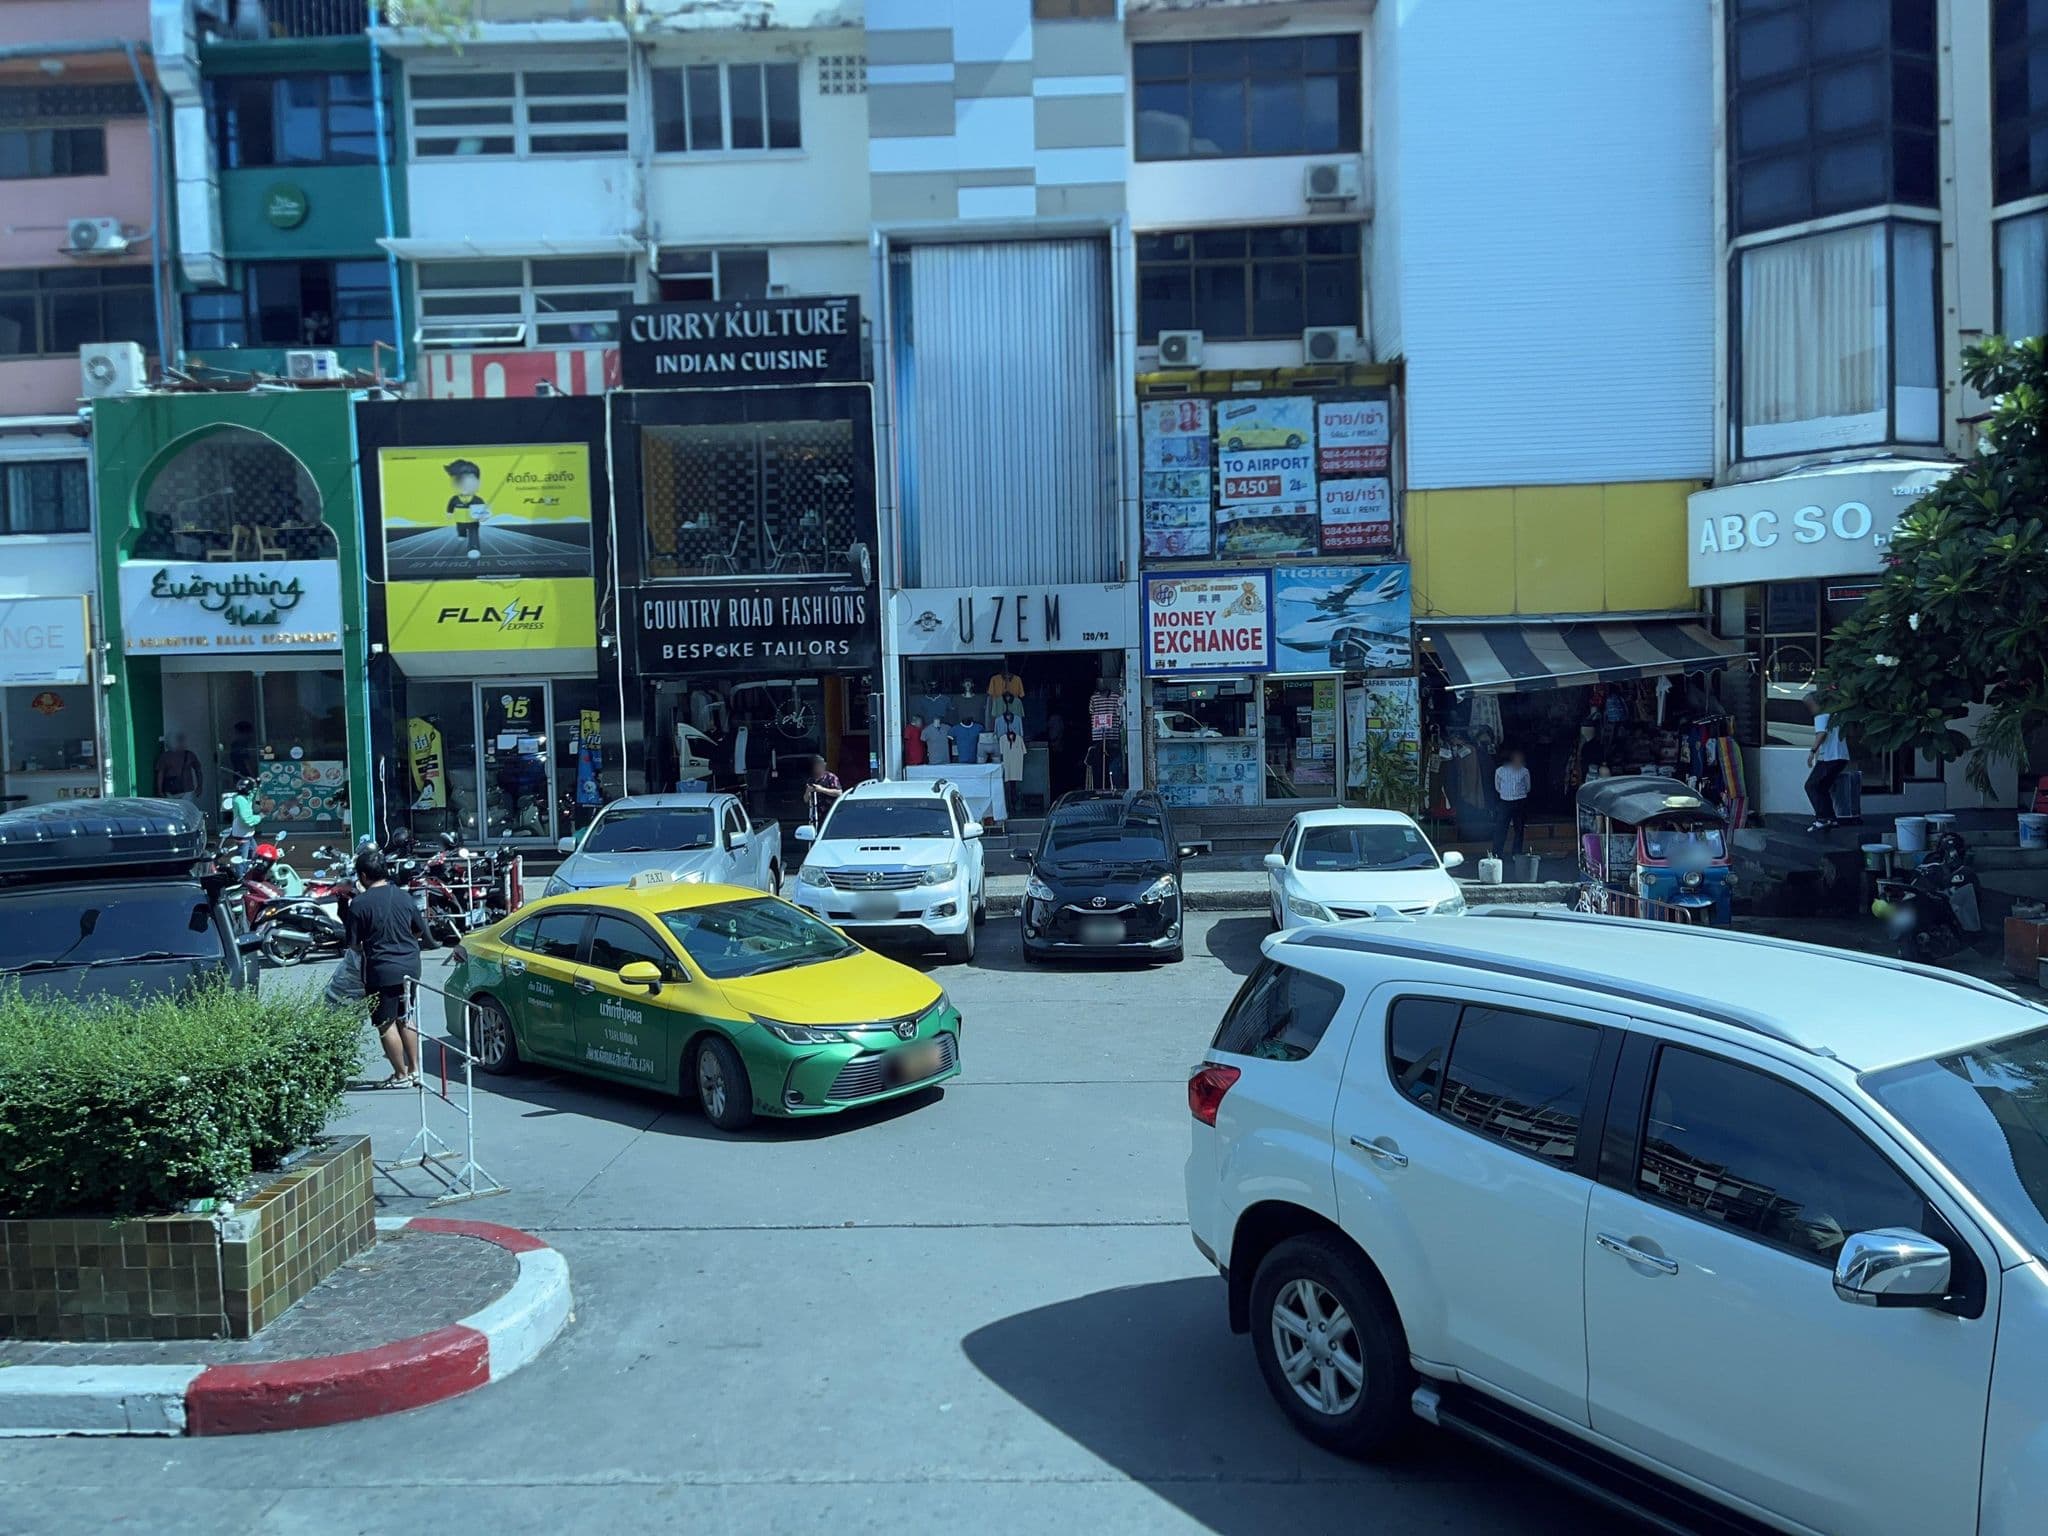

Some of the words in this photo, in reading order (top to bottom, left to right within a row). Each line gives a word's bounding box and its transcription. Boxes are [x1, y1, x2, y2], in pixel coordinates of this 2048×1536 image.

[630, 311, 720, 342] CURRY
[725, 306, 848, 338] KULTURE
[655, 352, 736, 374] INDIAN
[740, 348, 829, 371] CUISINE
[1324, 408, 1384, 426] ขาย/เช่า
[1224, 460, 1244, 472] TO
[1247, 456, 1311, 472] AIRPORT
[1326, 486, 1385, 503] ขาย/เช่า
[1359, 505, 1380, 513] RENT
[1700, 509, 1779, 555] ABC
[1793, 501, 1873, 544] SO
[1278, 567, 1364, 578] TICKETS
[643, 599, 721, 629] COUNTRY
[729, 598, 773, 627] ROAD
[782, 595, 865, 625] FASHIONS
[958, 594, 1061, 644] UZEM
[1153, 610, 1216, 627] MONEY
[507, 621, 544, 631] EXPRESS
[1082, 631, 1109, 642] 120/92
[1153, 627, 1263, 654] EXCHANGE
[662, 642, 754, 660] BESPOKE
[762, 639, 849, 657] TAILORS
[1388, 679, 1413, 687] WORLD
[504, 700, 528, 718] 15
[644, 871, 664, 884] TAXI
